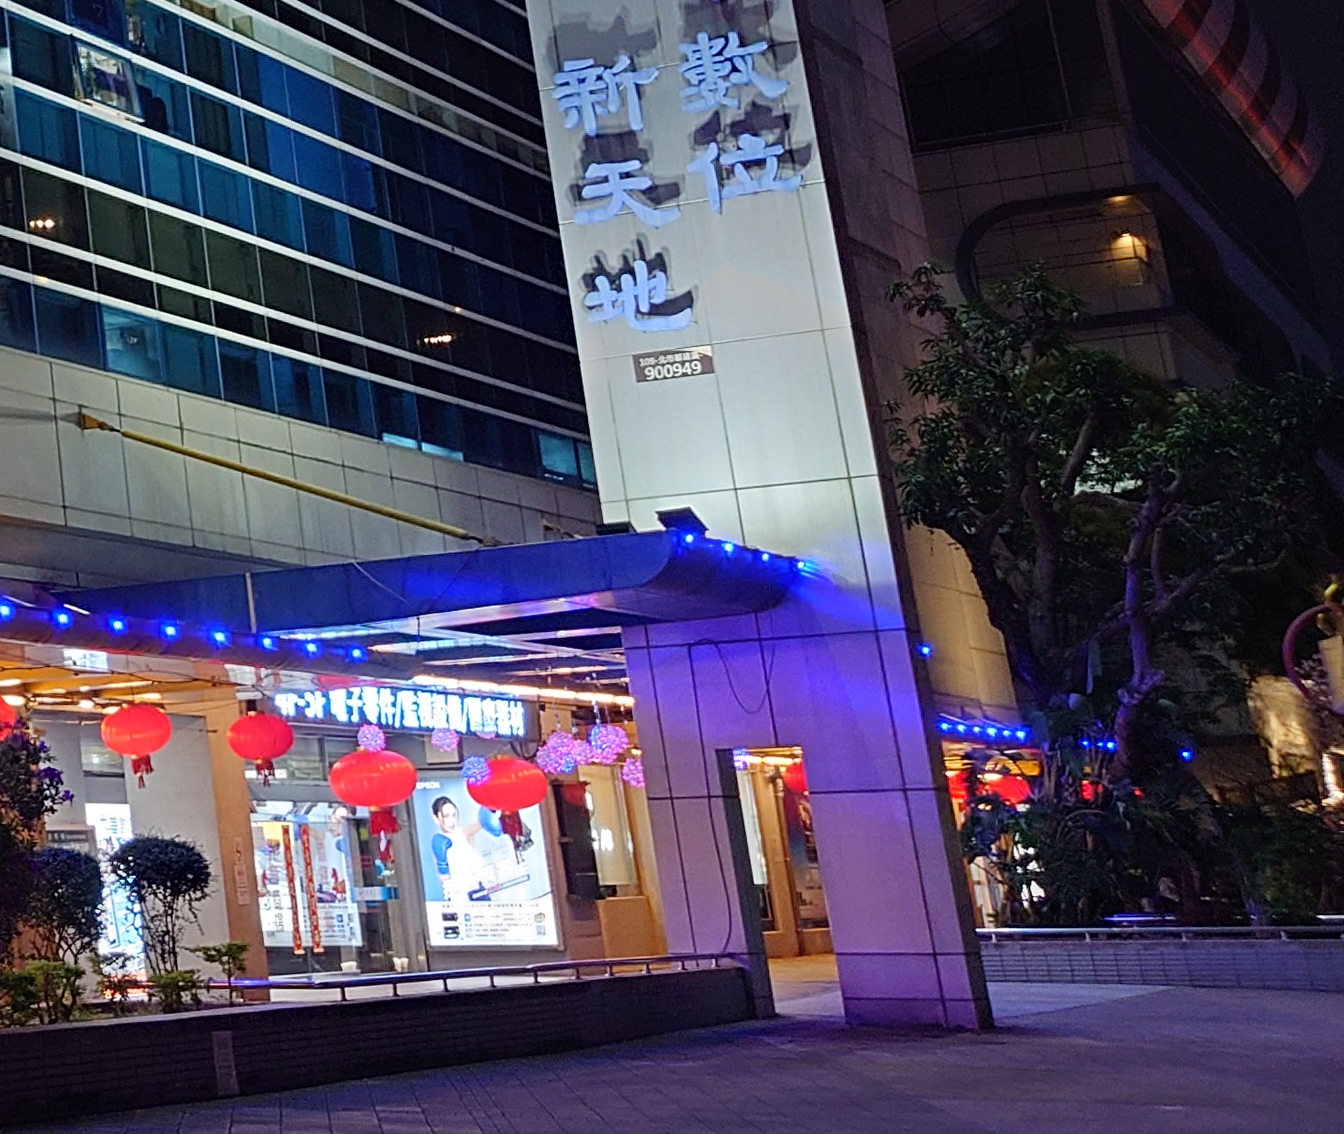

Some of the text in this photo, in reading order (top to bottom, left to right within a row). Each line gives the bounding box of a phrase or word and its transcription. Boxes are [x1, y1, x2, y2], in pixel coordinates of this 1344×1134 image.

[552, 54, 694, 333] 新天地
[643, 360, 702, 381] 900949
